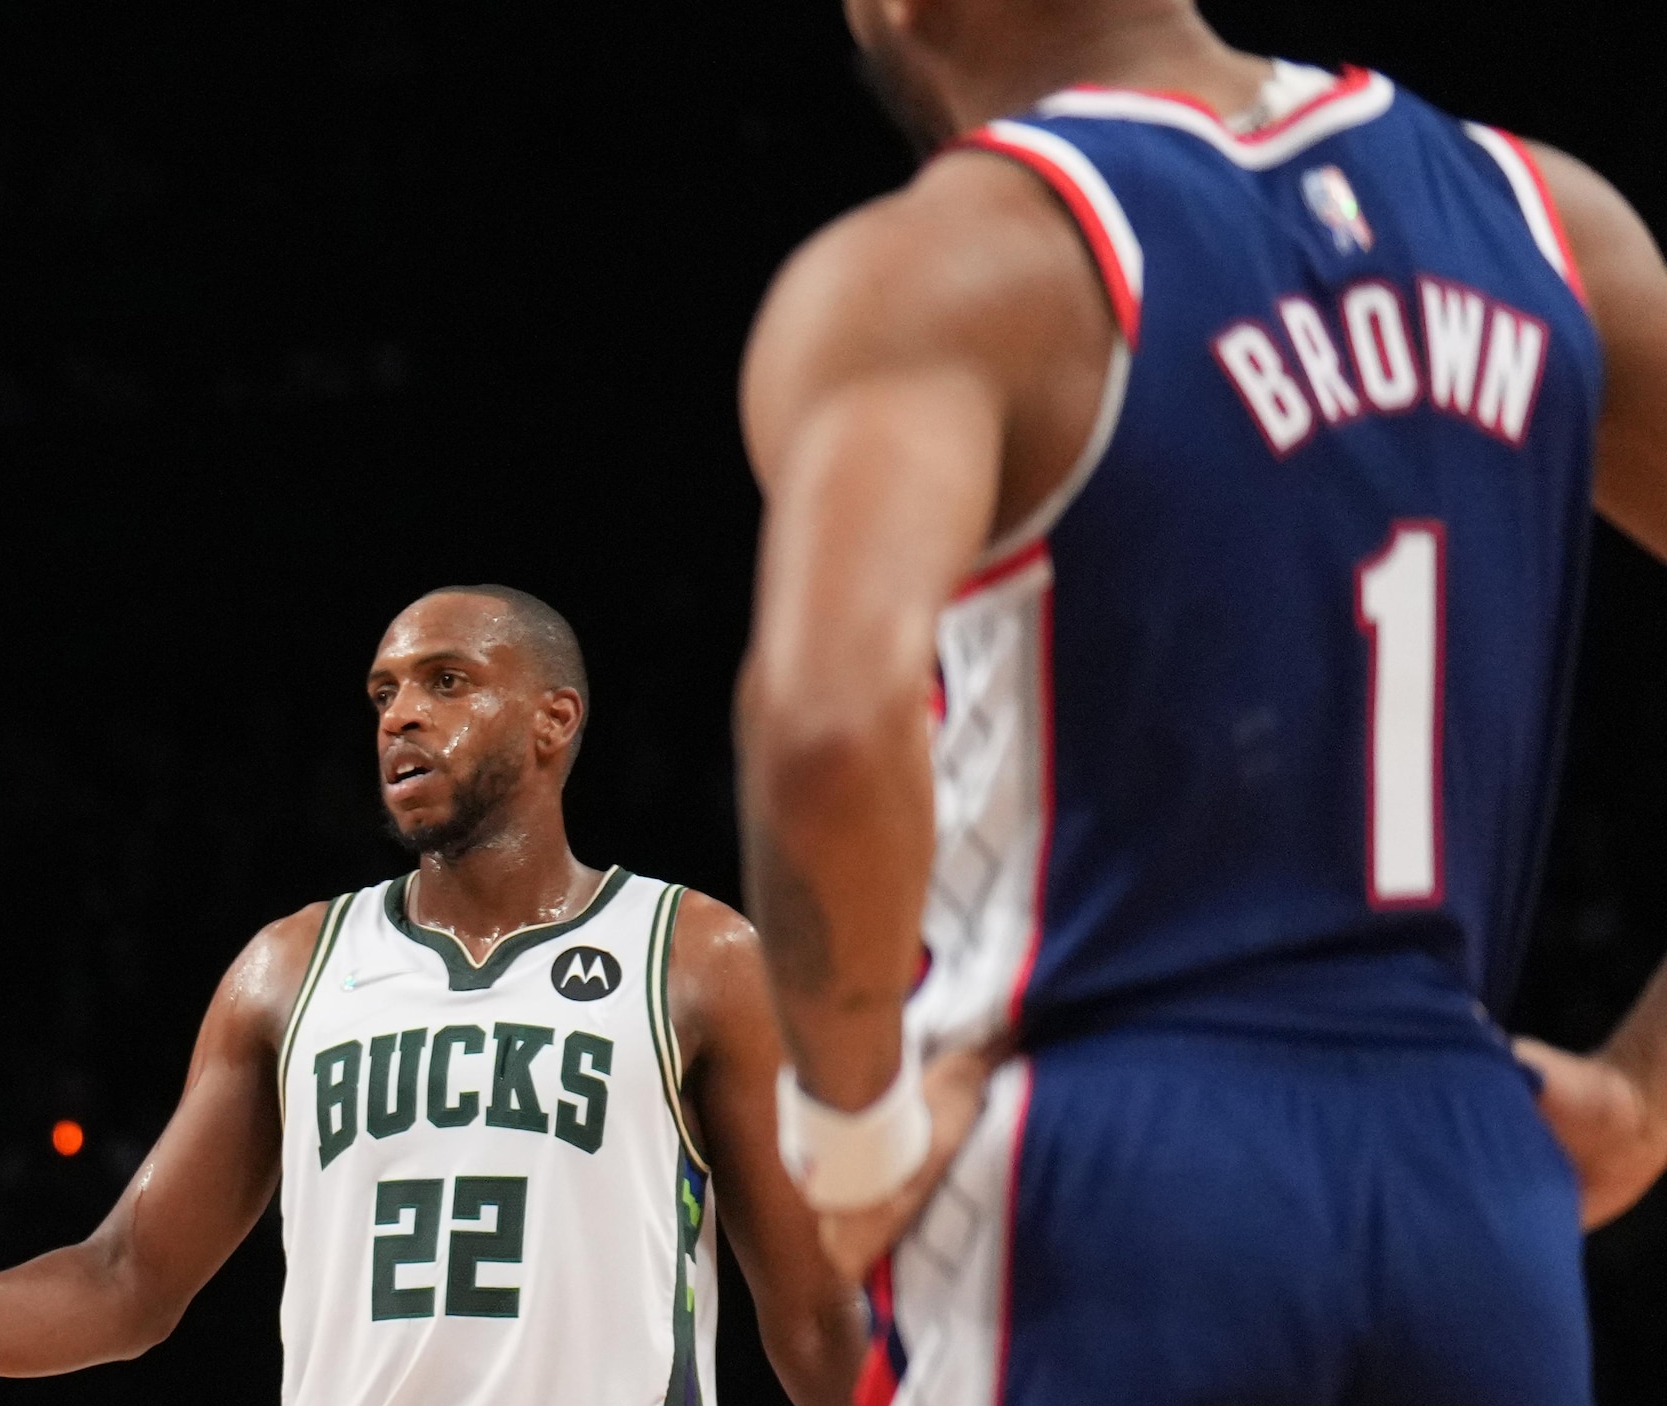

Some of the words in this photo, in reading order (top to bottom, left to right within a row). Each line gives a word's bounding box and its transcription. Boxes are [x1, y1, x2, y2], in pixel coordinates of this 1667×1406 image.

[1212, 275, 1549, 456] BROWN
[1355, 519, 1446, 909] 1
[313, 1022, 615, 1171] BUCKS
[372, 1176, 528, 1322] 22
